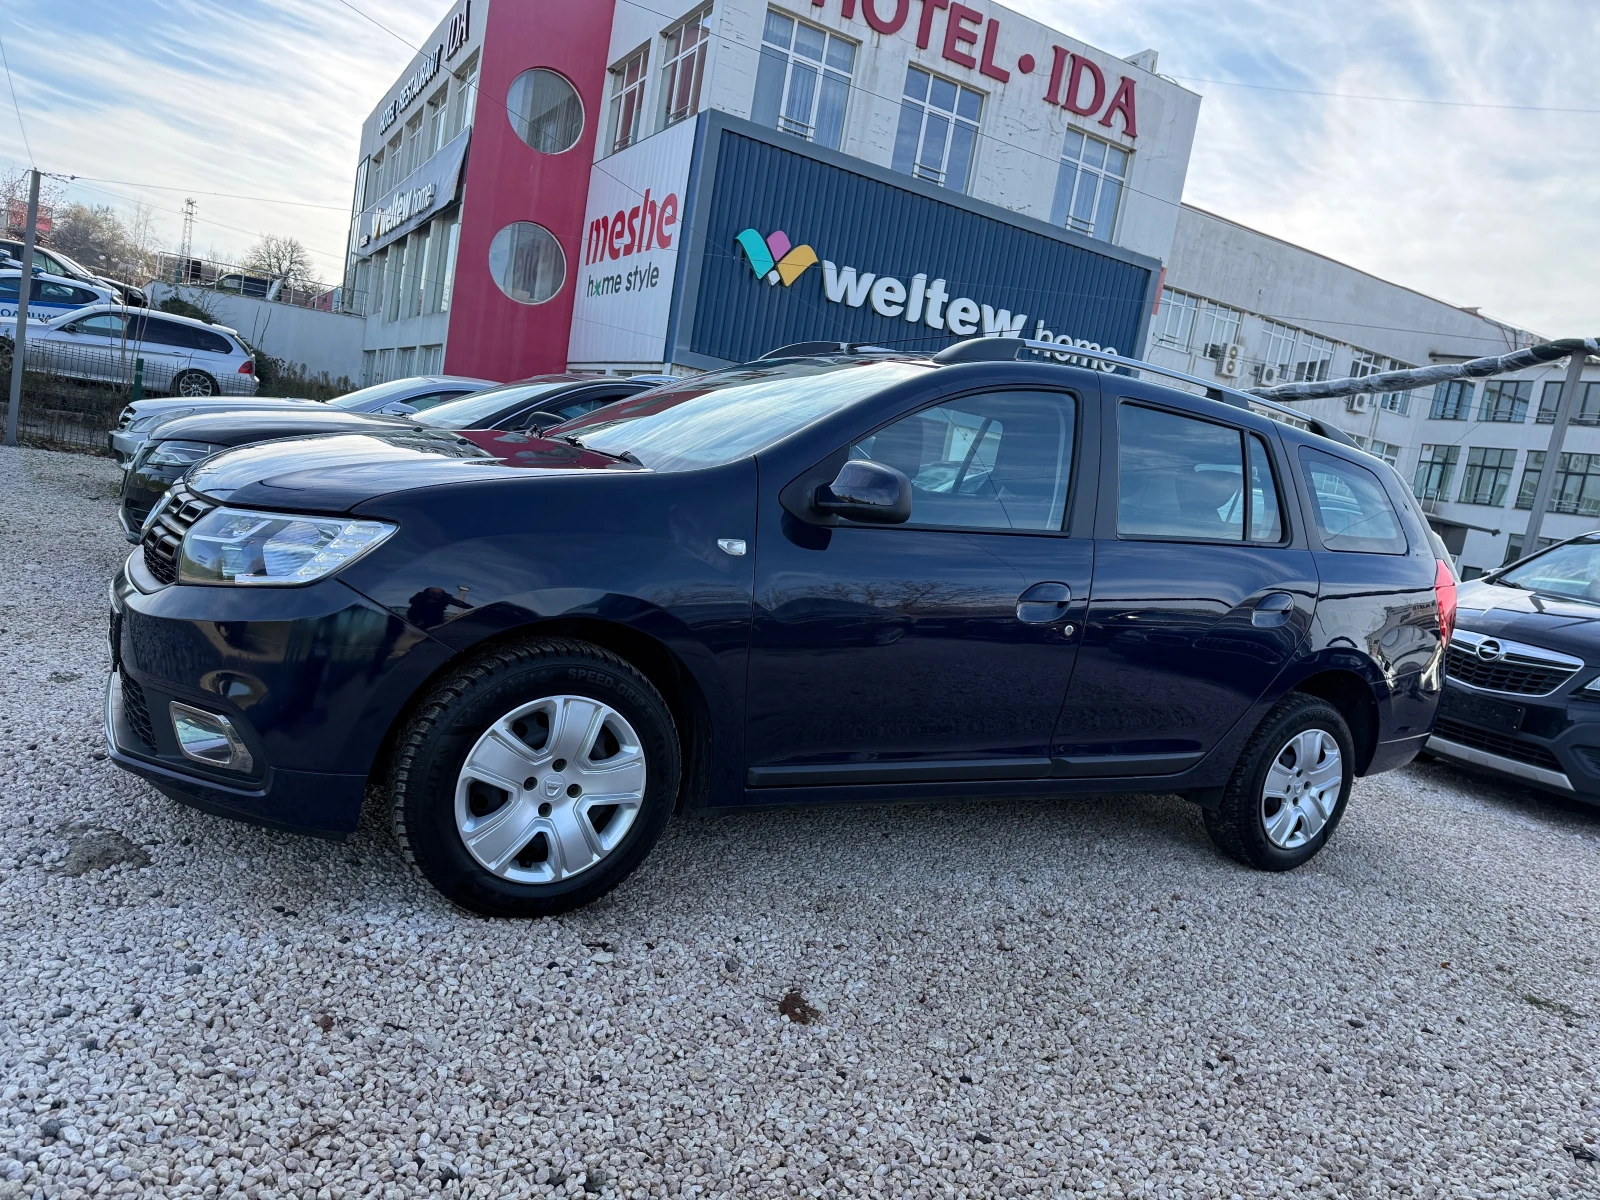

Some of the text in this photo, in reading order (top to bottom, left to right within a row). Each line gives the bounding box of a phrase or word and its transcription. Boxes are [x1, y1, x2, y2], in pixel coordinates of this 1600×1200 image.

[399, 44, 444, 114] RESTAURANT
[445, 0, 471, 62] IDA
[1042, 45, 1138, 138] IDA
[585, 188, 678, 266] meshe
[586, 261, 660, 298] hme style
[822, 259, 1118, 374] weltew home
[567, 668, 645, 708] SPEED-GRIP
